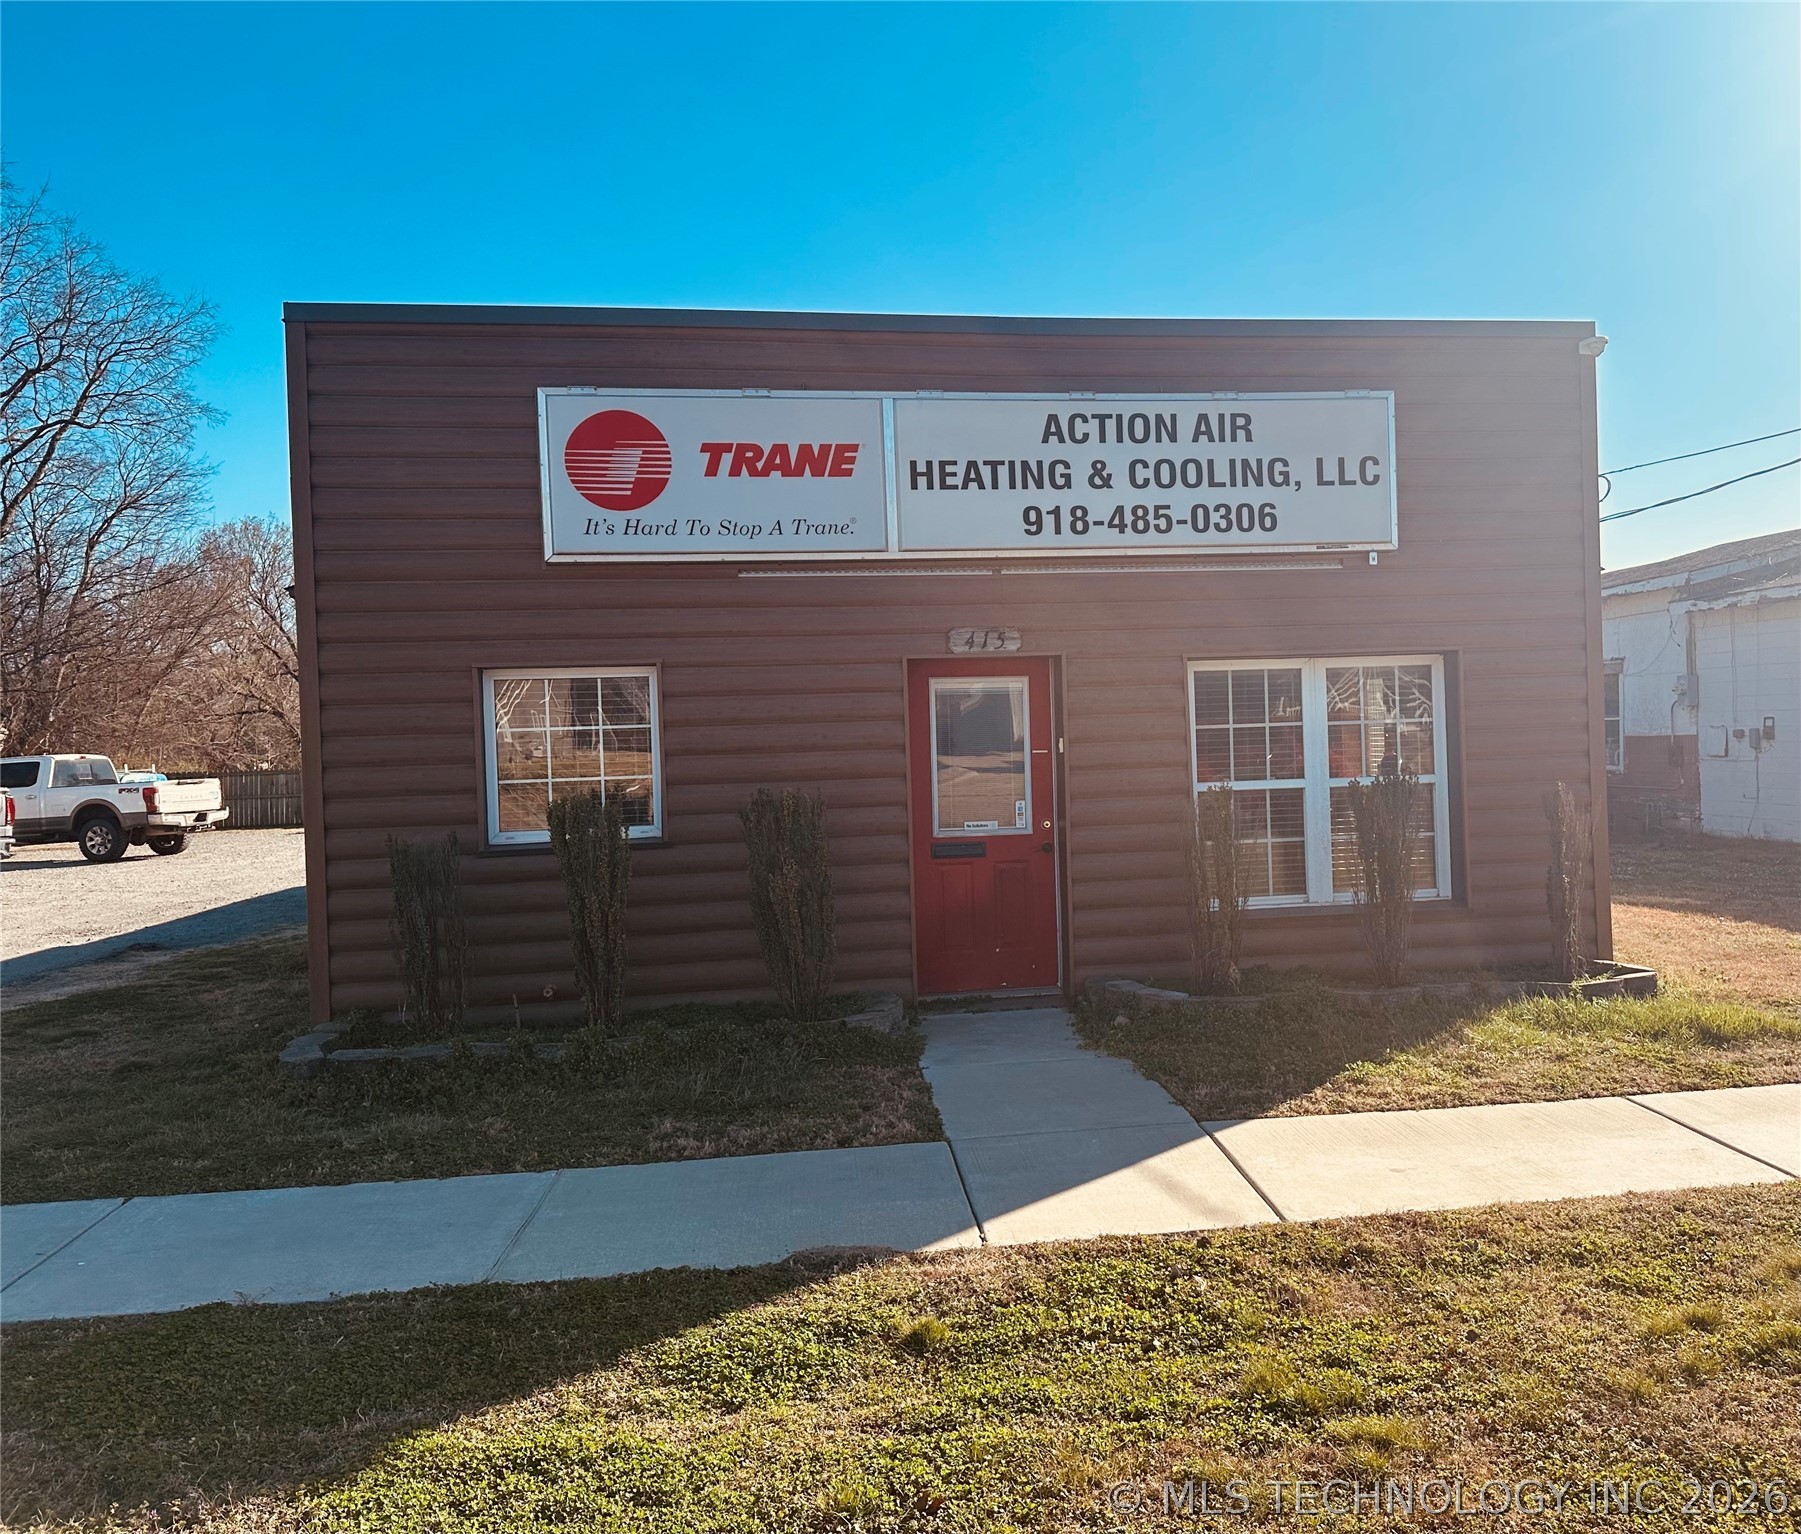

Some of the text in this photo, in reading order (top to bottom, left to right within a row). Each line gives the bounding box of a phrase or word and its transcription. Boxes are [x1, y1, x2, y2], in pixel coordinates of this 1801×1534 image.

[1041, 412, 1254, 444] ACTION AIR
[699, 442, 860, 478] TRANE
[909, 456, 1381, 492] HEATING & COOLING, LLC
[583, 518, 615, 536] It's
[622, 518, 678, 536] Hard
[685, 519, 711, 536] To
[717, 518, 762, 540] Stop
[768, 519, 783, 536] A
[1022, 502, 1279, 536] 918-485-0306
[964, 630, 1007, 650] 415
